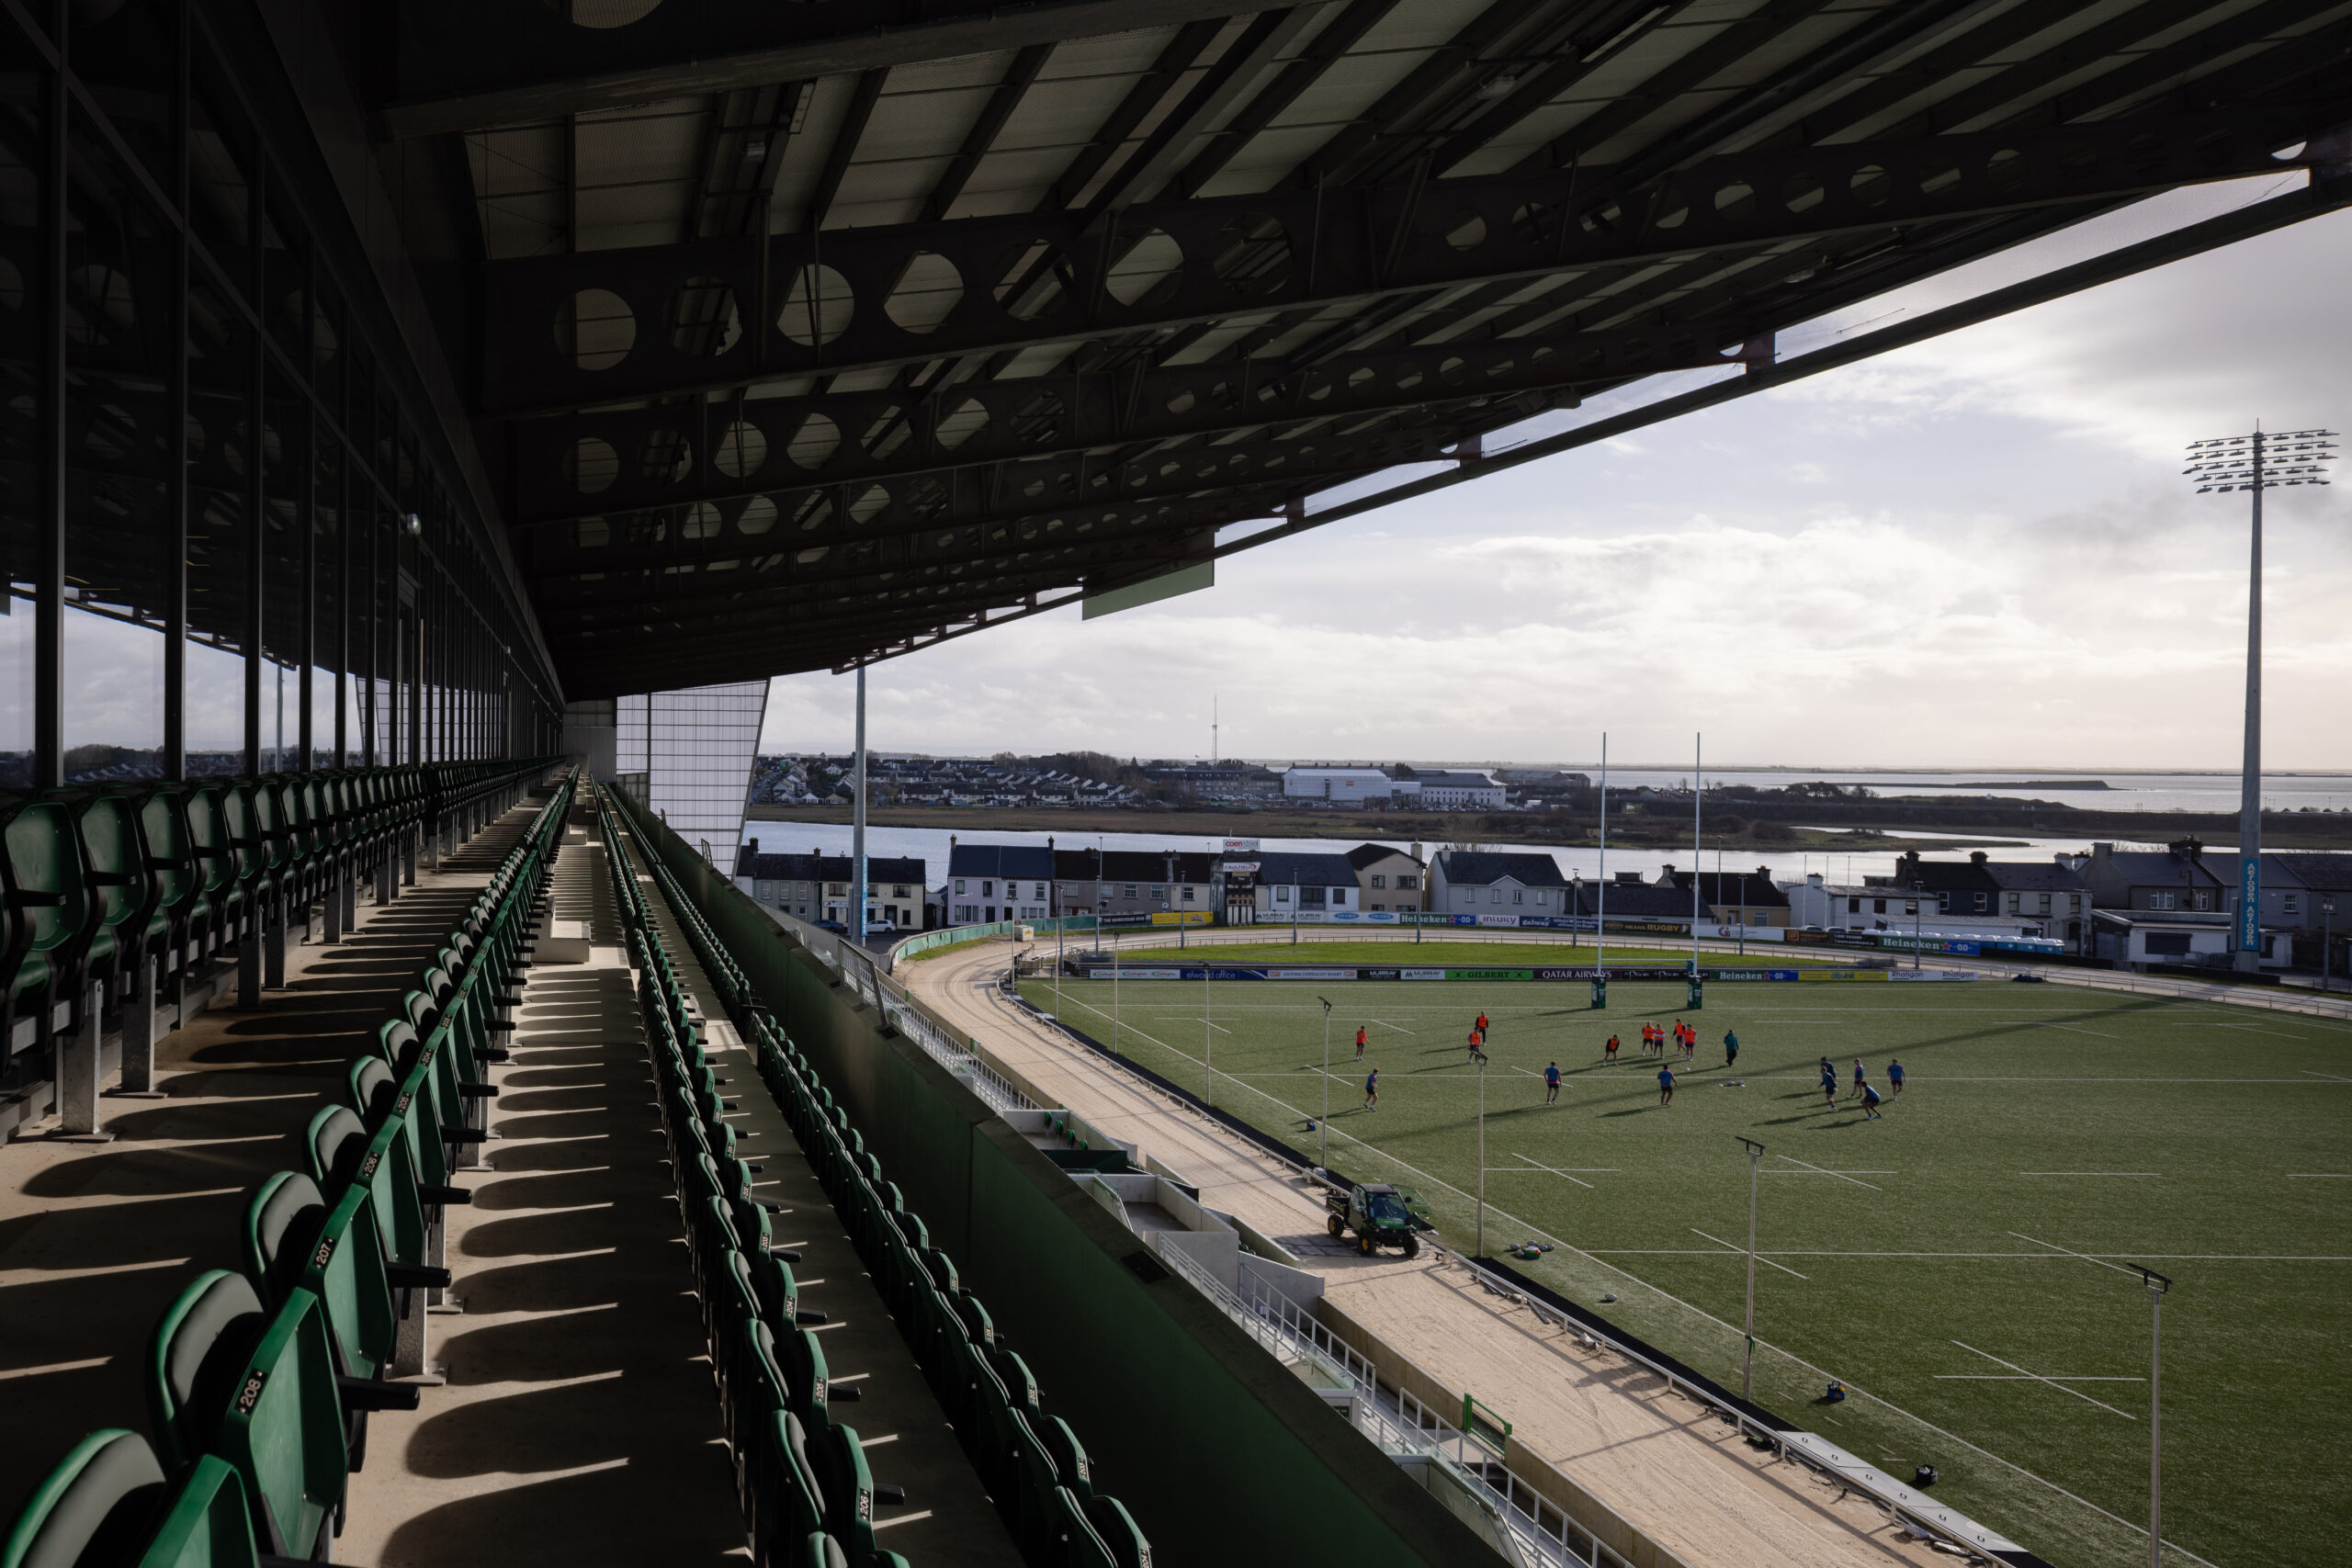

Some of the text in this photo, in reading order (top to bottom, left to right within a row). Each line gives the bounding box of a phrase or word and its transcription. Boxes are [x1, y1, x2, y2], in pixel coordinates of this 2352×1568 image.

[2246, 863, 2256, 945] Aerogen Aerogen
[1522, 919, 1550, 927] galway
[1646, 924, 1680, 932] RUGBY
[1883, 938, 1939, 950] Heineken
[1216, 970, 1236, 979] office
[1543, 970, 1611, 979] QATAR AIRWYS
[1720, 971, 1762, 980] Heineken
[1892, 970, 1924, 978] Rhatigan
[1943, 970, 1974, 978] Rhatigan
[422, 1051, 431, 1064] 204
[398, 1096, 410, 1111] 205
[364, 1156, 378, 1174] 206
[315, 1243, 333, 1265] 207
[786, 1301, 794, 1314] 204
[240, 1378, 262, 1407] 208
[815, 1381, 825, 1397] 205
[859, 1495, 869, 1516] 206
